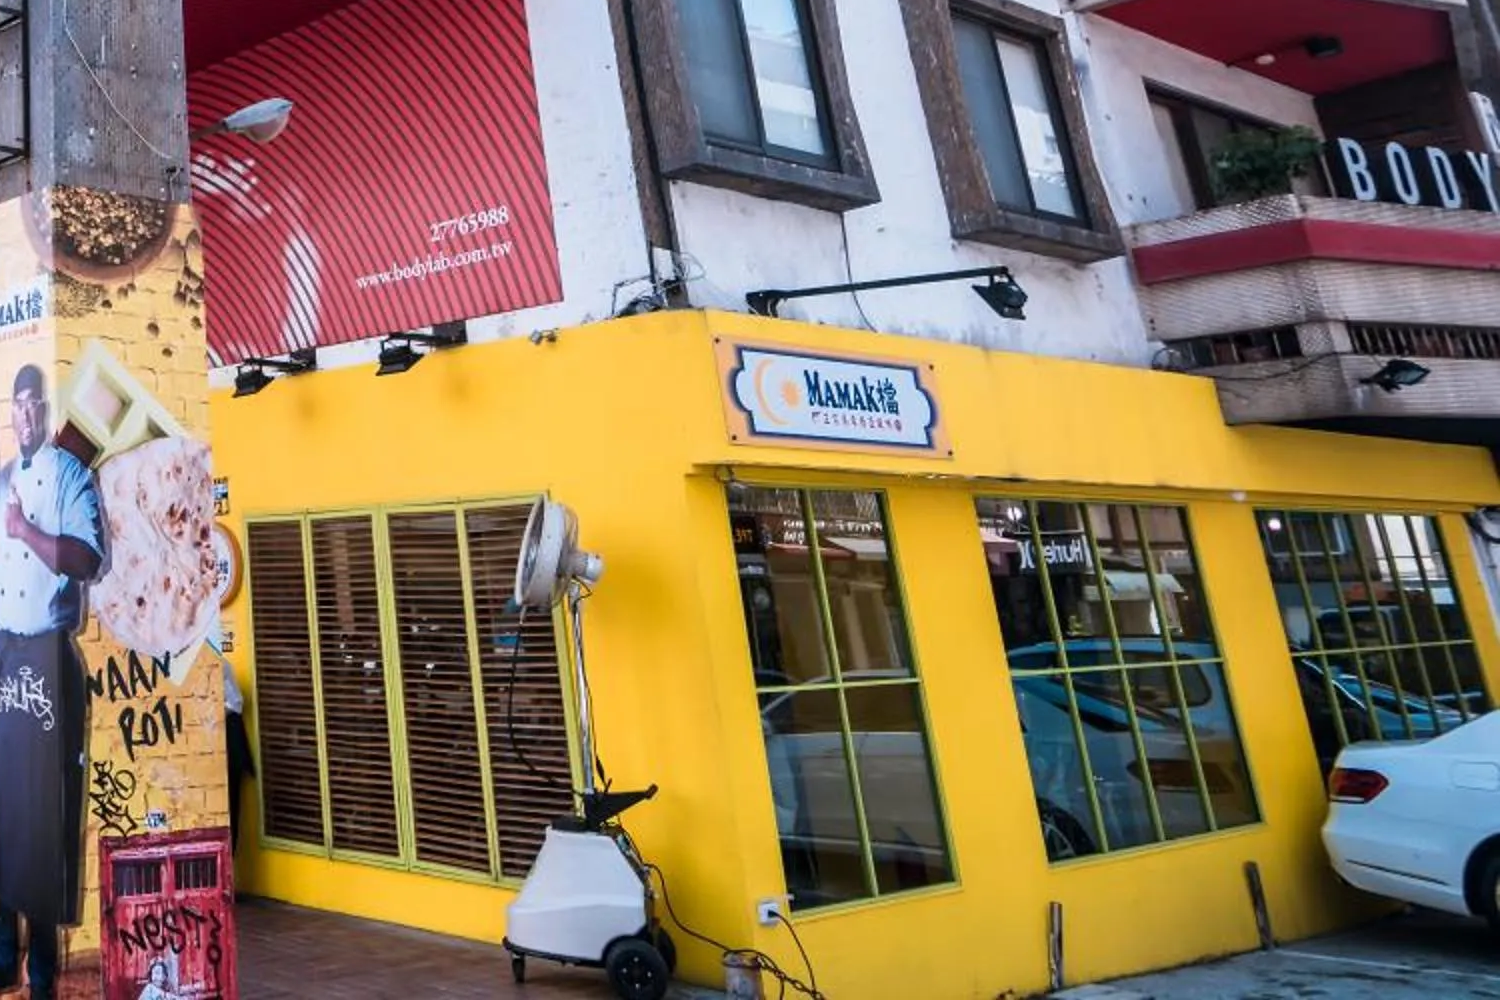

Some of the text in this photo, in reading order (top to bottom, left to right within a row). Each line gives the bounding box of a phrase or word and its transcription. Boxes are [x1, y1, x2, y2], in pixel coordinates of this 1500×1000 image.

[1337, 137, 1500, 214] BODY
[429, 205, 510, 243] 27765988
[355, 240, 512, 289] www.bodylab.com.tw
[86, 649, 171, 702] NAAN
[117, 695, 183, 762] ROTI
